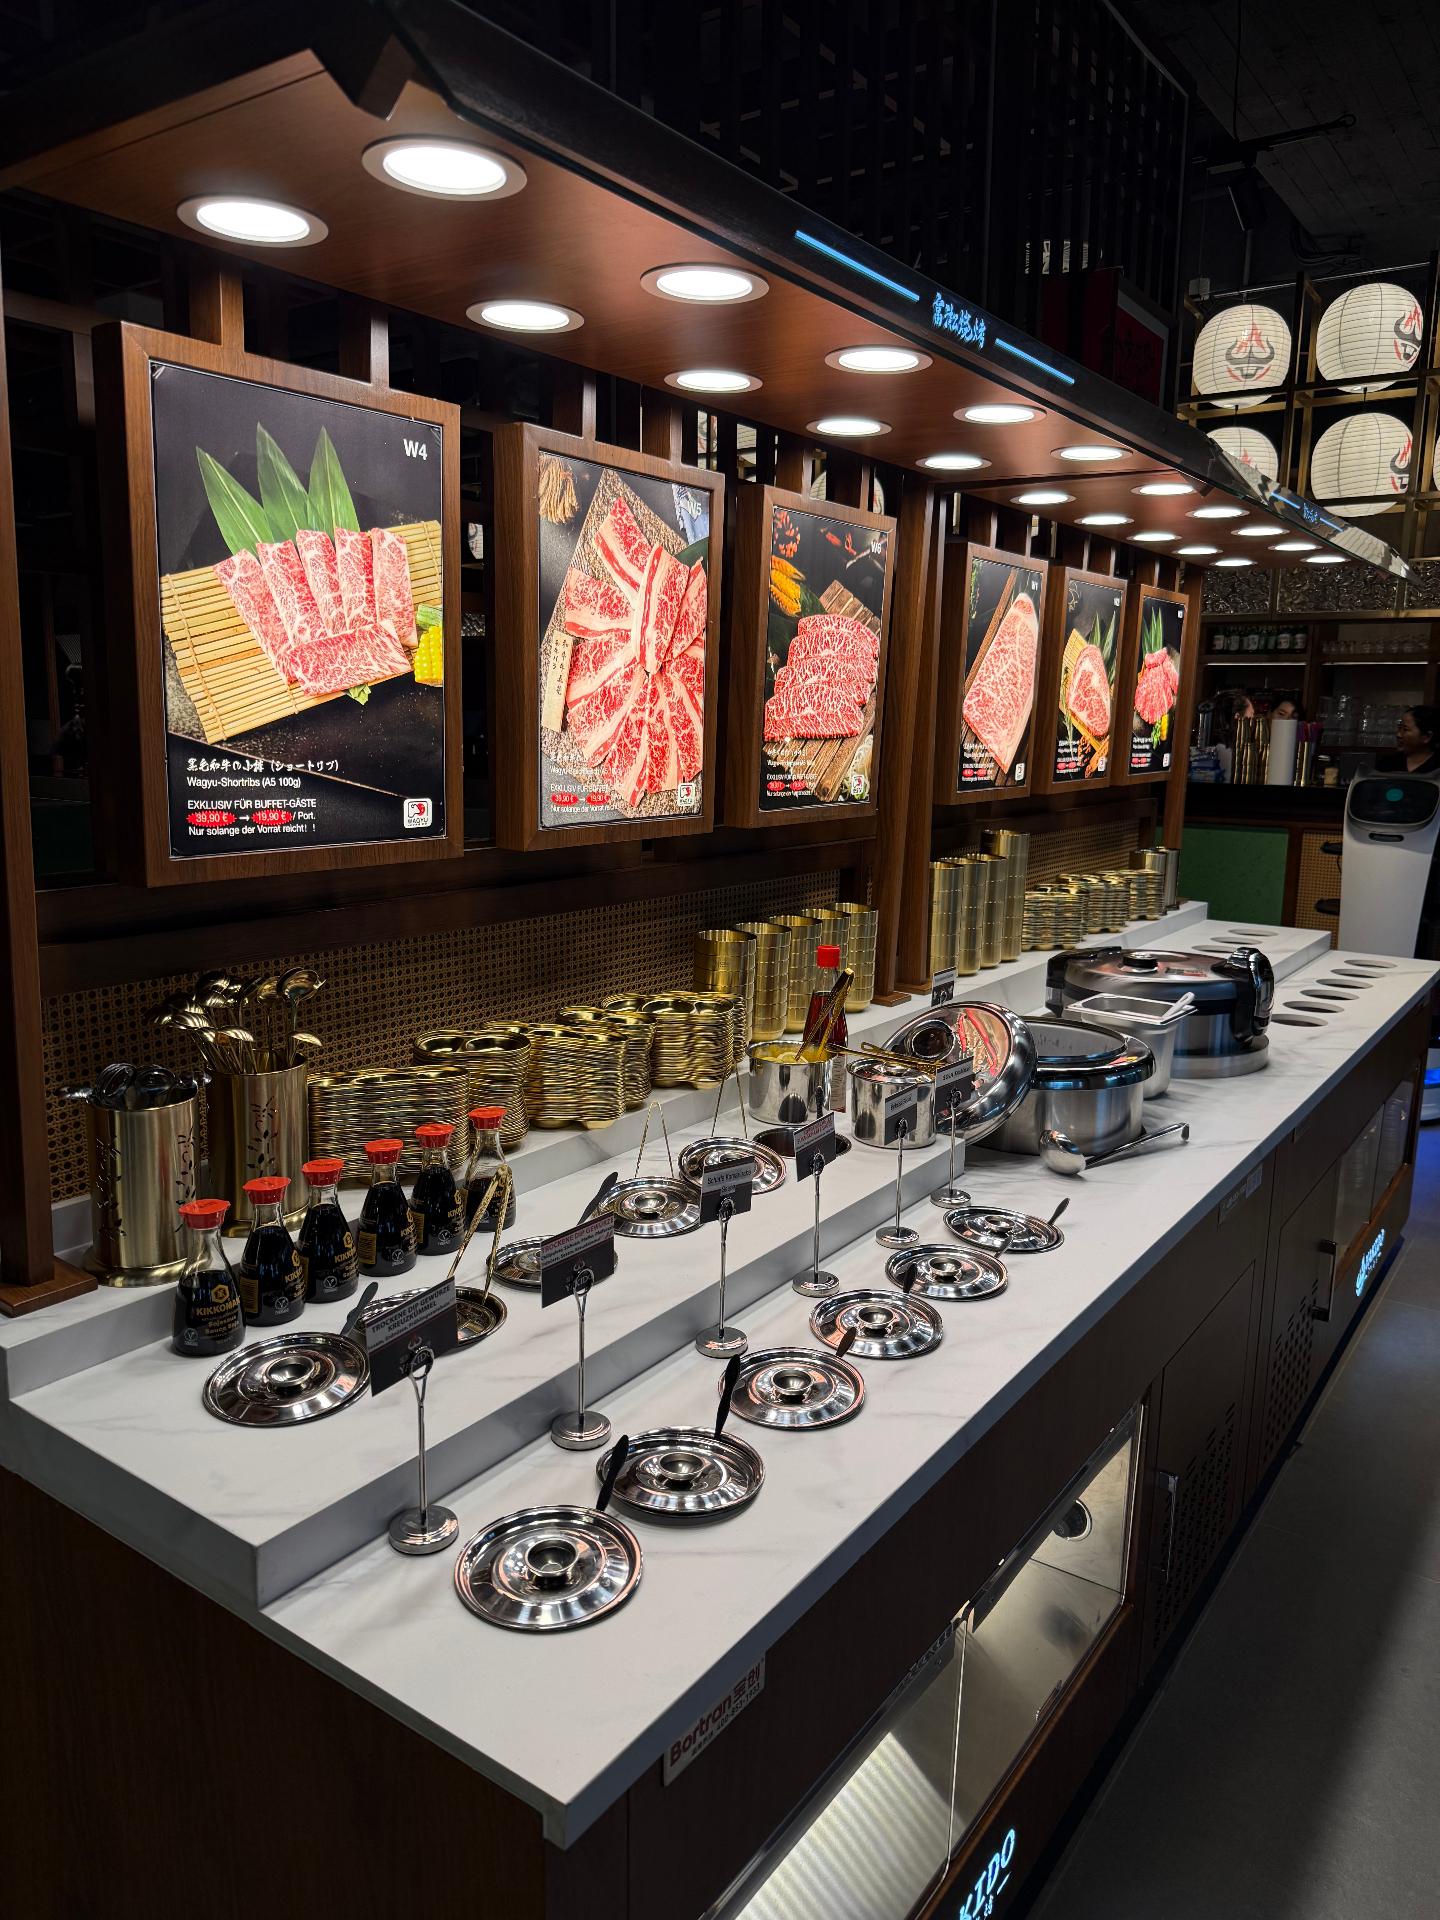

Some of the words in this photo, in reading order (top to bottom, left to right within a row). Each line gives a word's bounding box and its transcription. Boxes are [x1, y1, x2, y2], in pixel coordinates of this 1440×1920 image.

[403, 438, 428, 461] W4
[187, 776, 260, 789] Wagyu-Shortribs
[261, 776, 276, 789] (A5
[279, 776, 301, 788] 100g)
[550, 783, 577, 792] EXKLUSIV
[187, 799, 233, 810] EXKLUSIV
[234, 797, 253, 809] FÜR
[254, 797, 317, 809] BUFFET-GÄSTE
[590, 794, 604, 802] 19,90
[195, 813, 220, 824] 39,90
[222, 813, 228, 822] €
[257, 812, 280, 822] 19,90
[281, 812, 287, 821] €
[297, 811, 316, 820] Port.
[188, 826, 204, 836] Nur
[206, 825, 240, 837] solange
[241, 825, 256, 834] der
[256, 824, 281, 834] Vorrat
[282, 824, 308, 833] reicht!
[541, 1234, 574, 1254] TROCKENE
[574, 1229, 585, 1240] DIP
[196, 1295, 241, 1316] KIKKOMAN
[371, 1309, 407, 1333] TROCKENE
[407, 1302, 420, 1314] DIP
[420, 1284, 451, 1306] GEWÜRZE
[388, 1300, 437, 1332] KREUZKÜMMEL
[669, 1694, 732, 1768] Bortran
